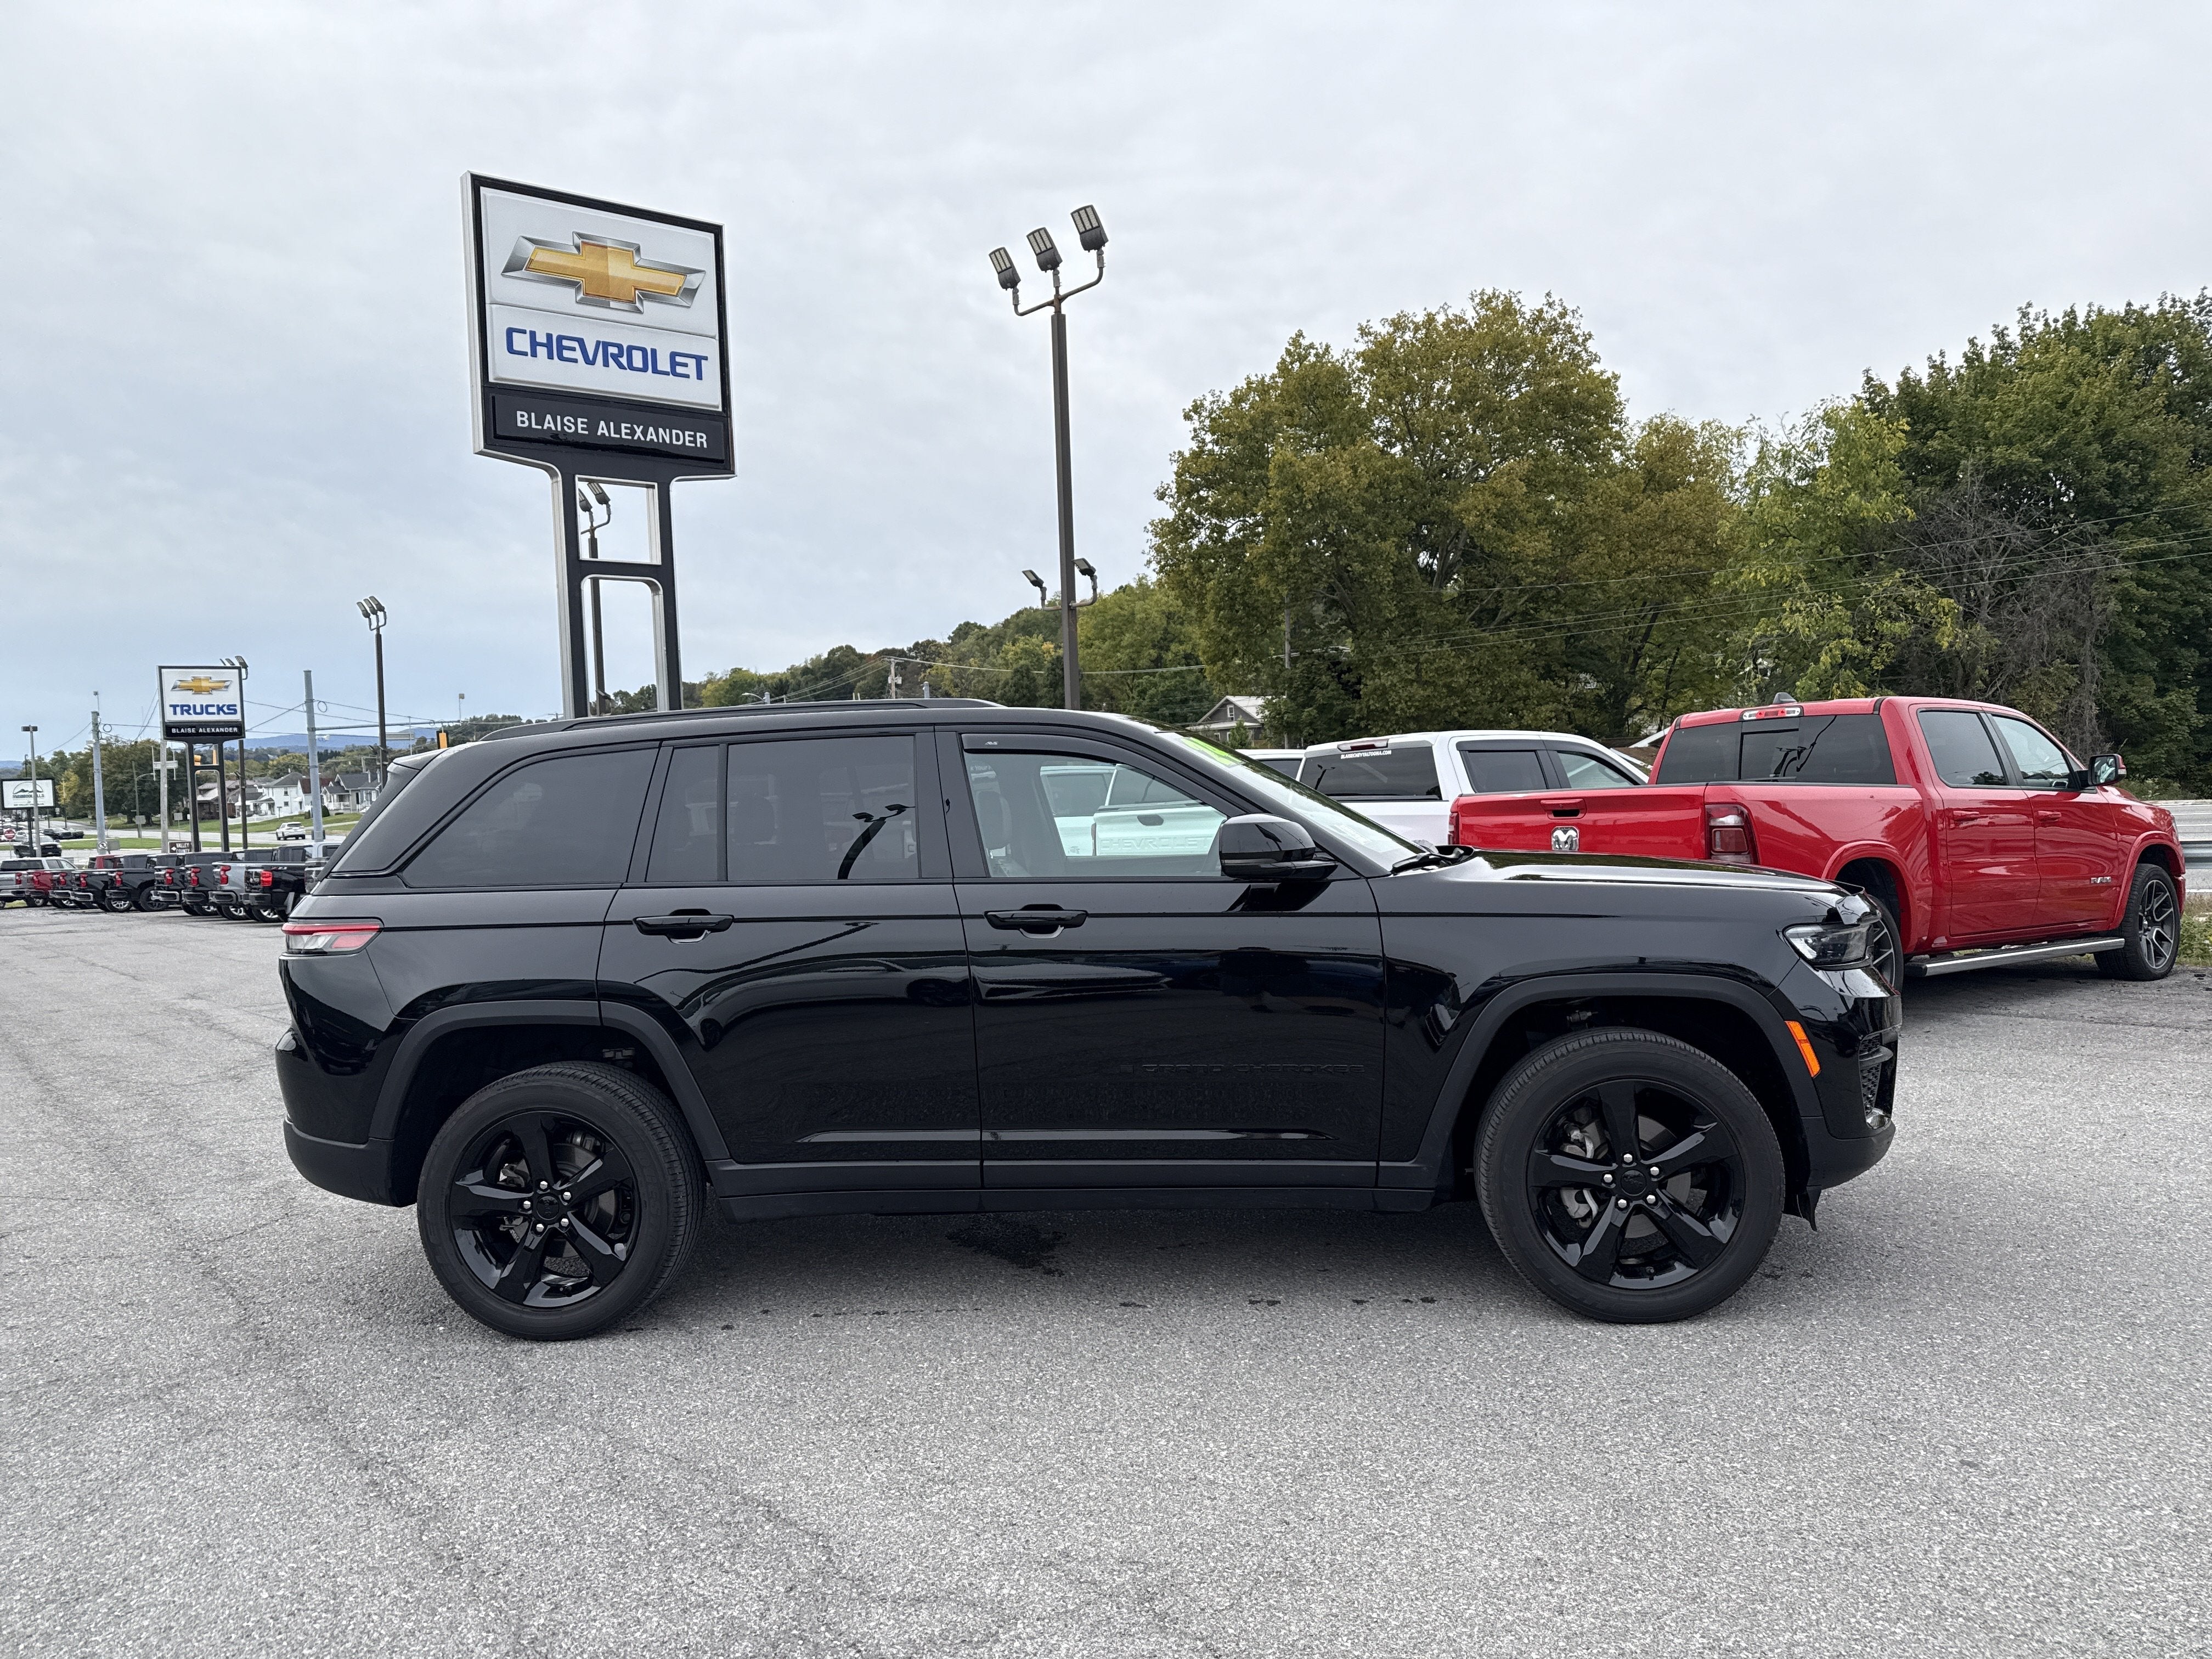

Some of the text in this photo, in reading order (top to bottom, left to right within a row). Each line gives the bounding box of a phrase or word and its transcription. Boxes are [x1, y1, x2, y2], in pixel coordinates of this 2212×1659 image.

[506, 326, 708, 380] CHEVROLET
[516, 410, 708, 448] BLAISE ALEXANDER
[169, 704, 238, 715] TRUCKS
[1142, 1064, 1365, 1074] GRAND CHEROKEE
